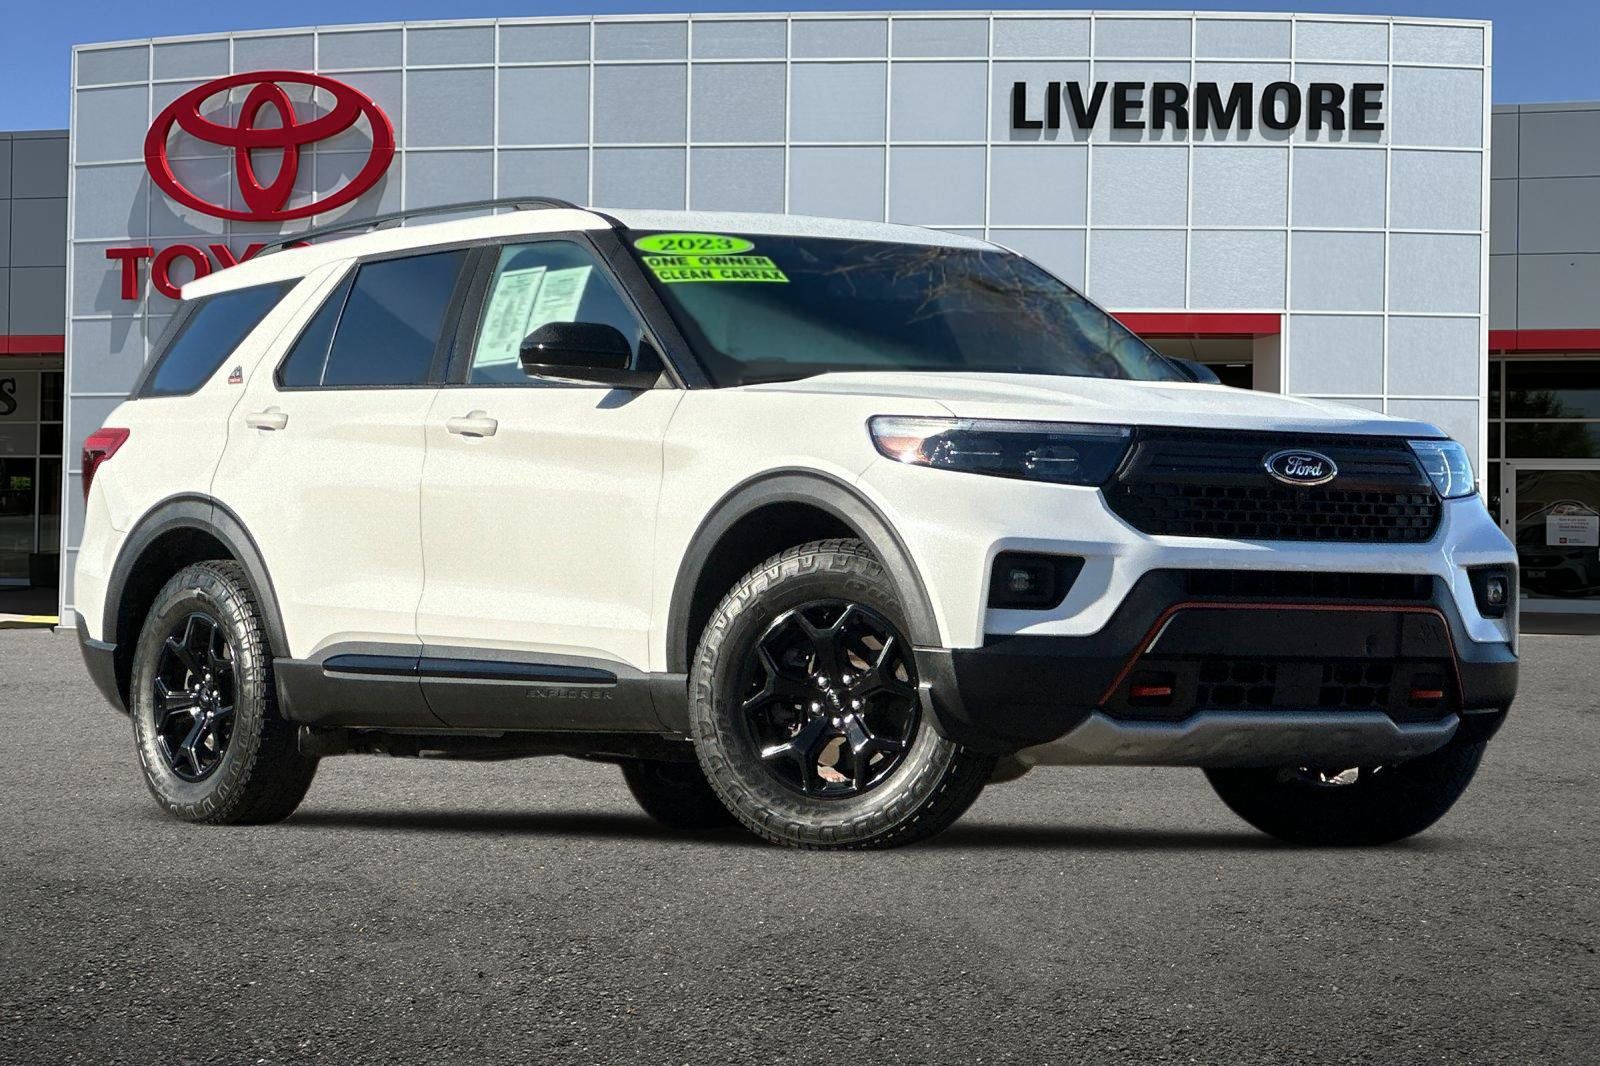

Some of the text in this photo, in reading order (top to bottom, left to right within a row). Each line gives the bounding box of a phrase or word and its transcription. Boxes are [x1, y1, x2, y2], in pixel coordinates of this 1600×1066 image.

[1013, 81, 1385, 131] LIVERMORE
[658, 237, 734, 251] 2023
[648, 256, 770, 267] ONE OWNER
[659, 269, 786, 280] CLEAN CARFAX
[1285, 455, 1323, 476] Ford
